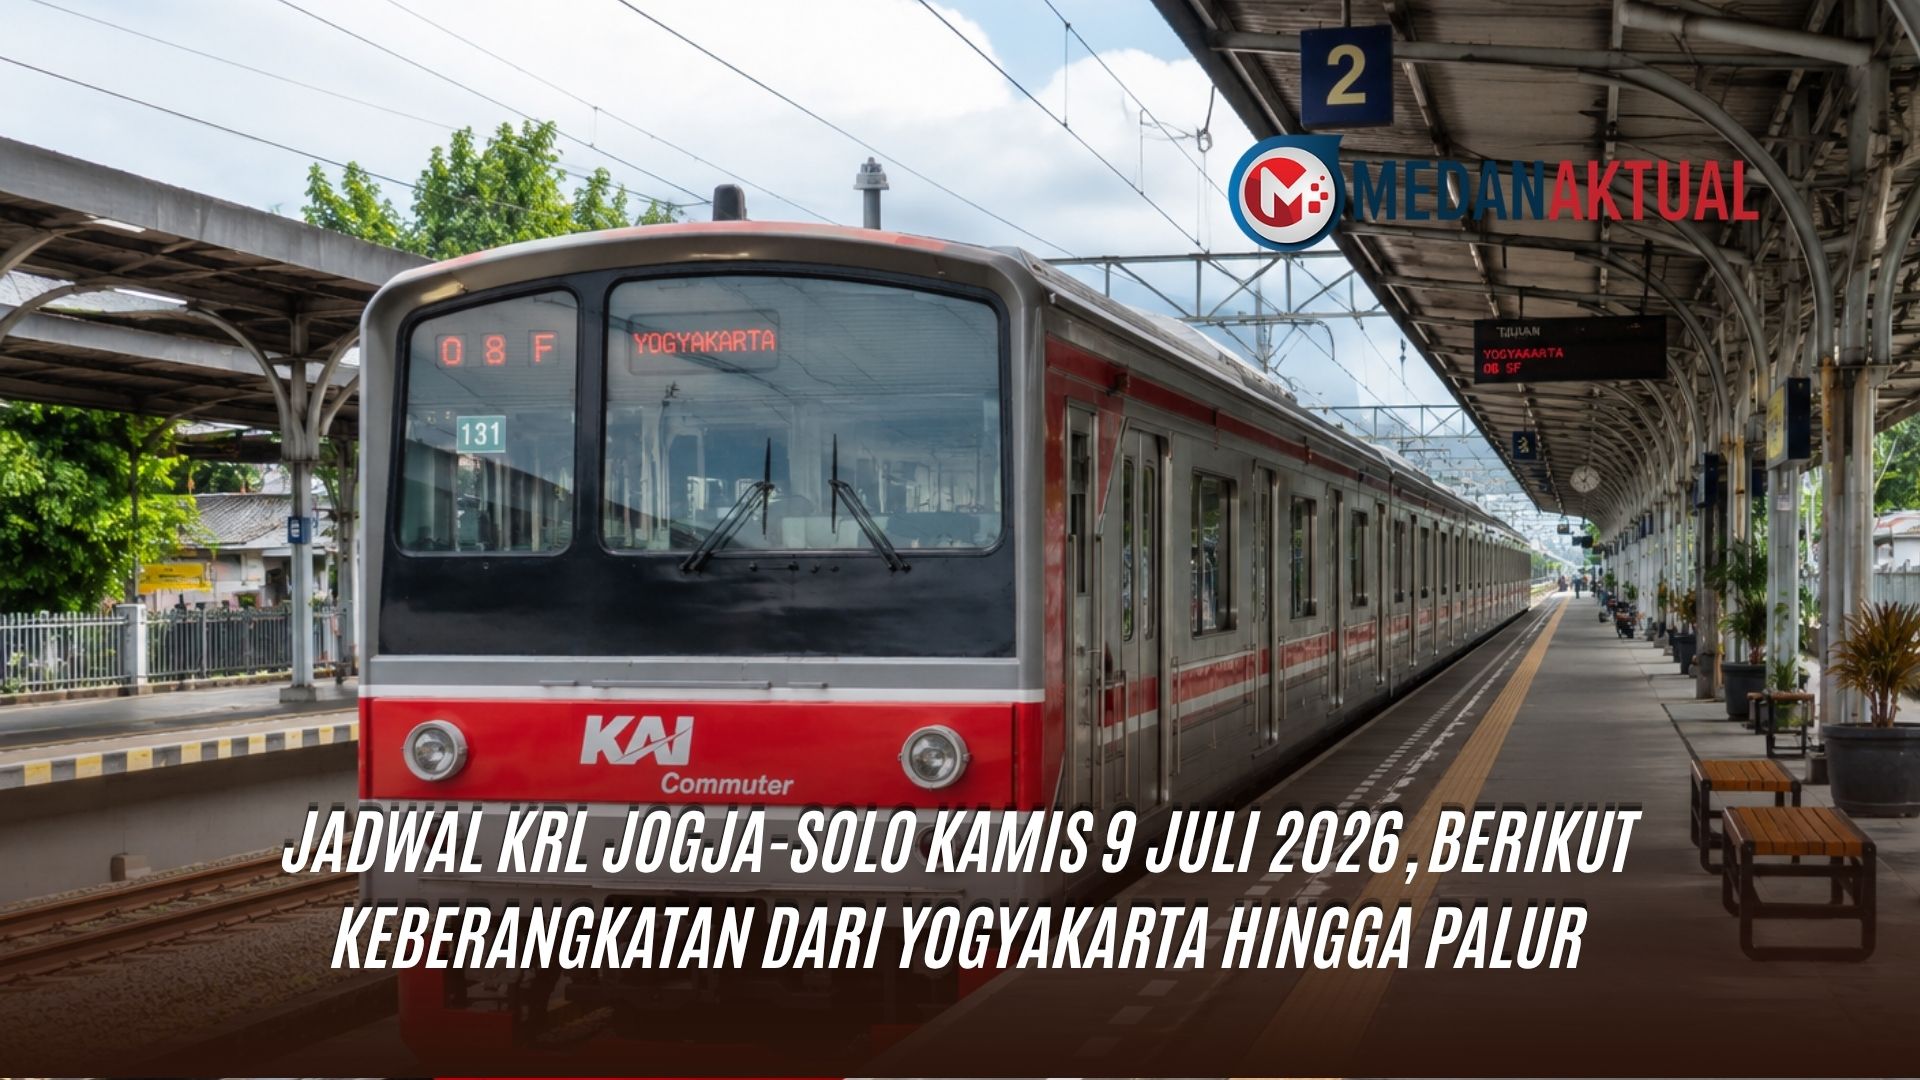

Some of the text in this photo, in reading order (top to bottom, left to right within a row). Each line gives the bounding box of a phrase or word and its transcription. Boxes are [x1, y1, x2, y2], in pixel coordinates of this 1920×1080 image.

[1326, 44, 1367, 105] 2
[633, 329, 776, 355] YOGYAKARTA
[461, 421, 500, 446] 131
[580, 715, 694, 765] KAI
[661, 771, 794, 796] Commuter
